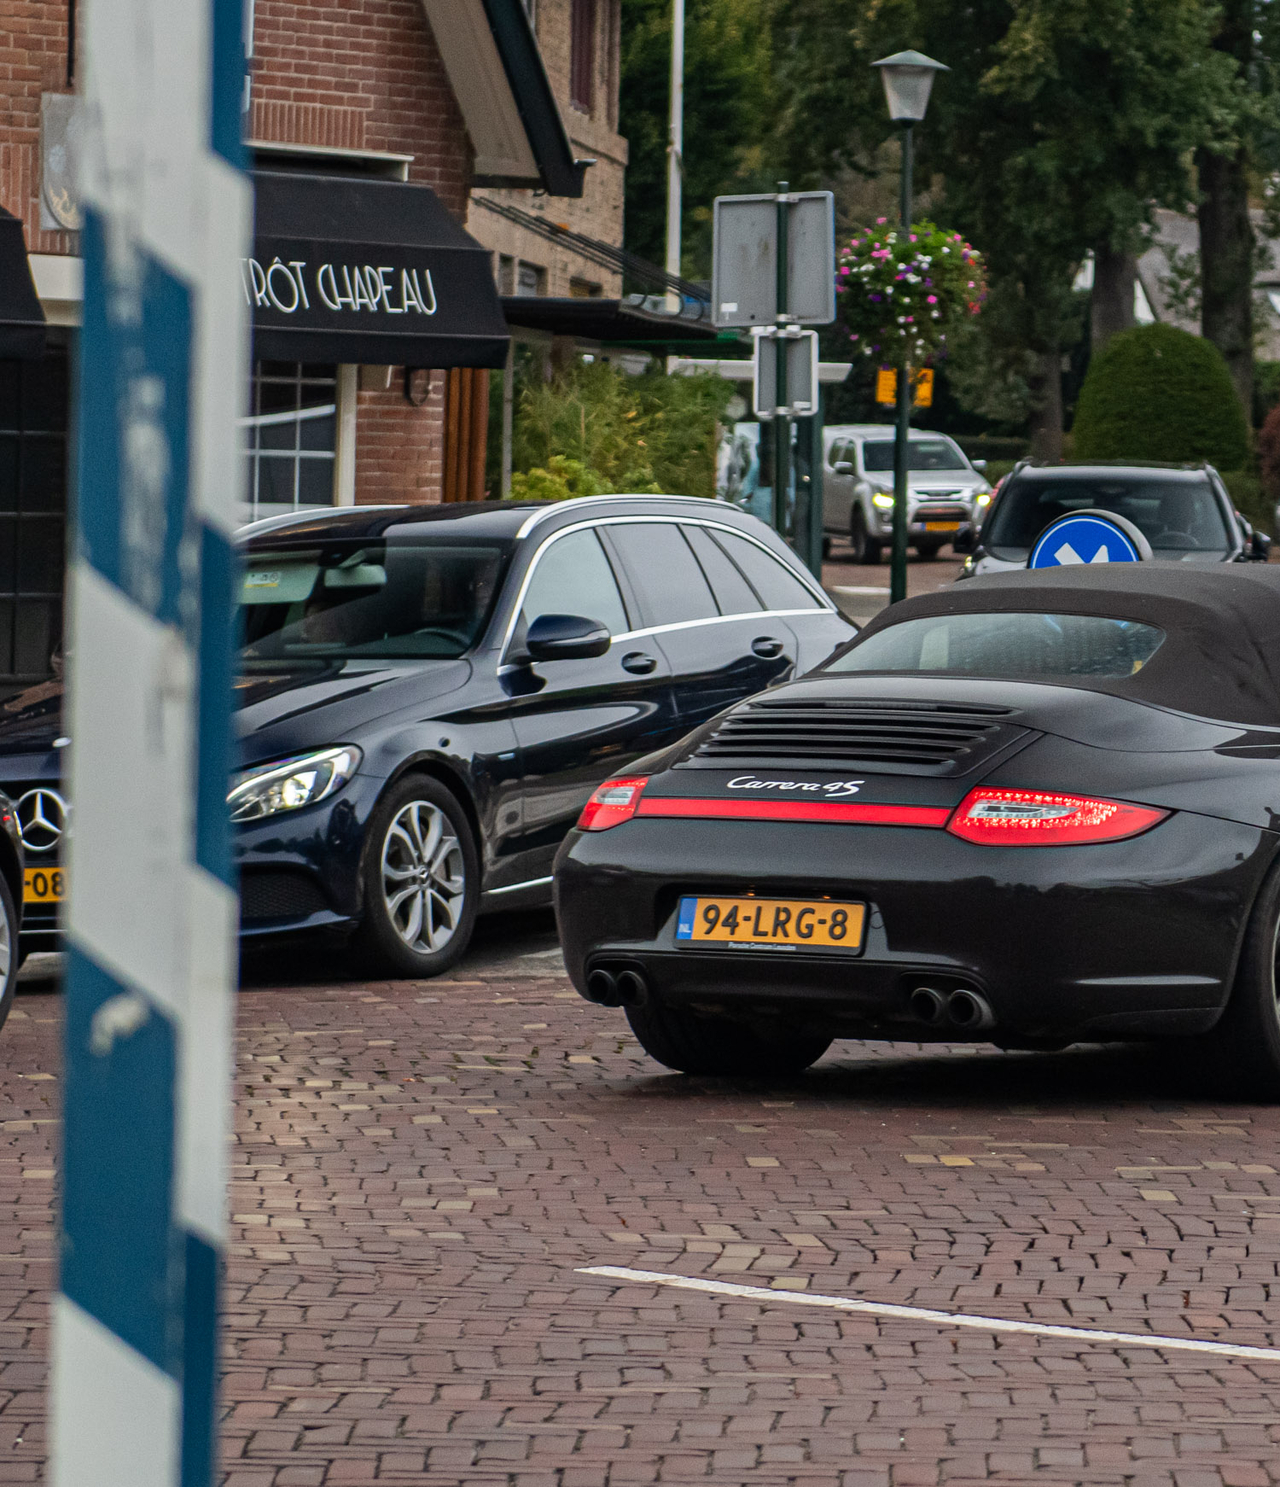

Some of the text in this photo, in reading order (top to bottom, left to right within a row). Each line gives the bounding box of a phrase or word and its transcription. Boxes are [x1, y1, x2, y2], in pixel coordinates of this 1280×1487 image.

[317, 263, 438, 316] CHAPEAU
[726, 775, 866, 797] Carrera 4S
[702, 904, 849, 941] 94-LRG-8
